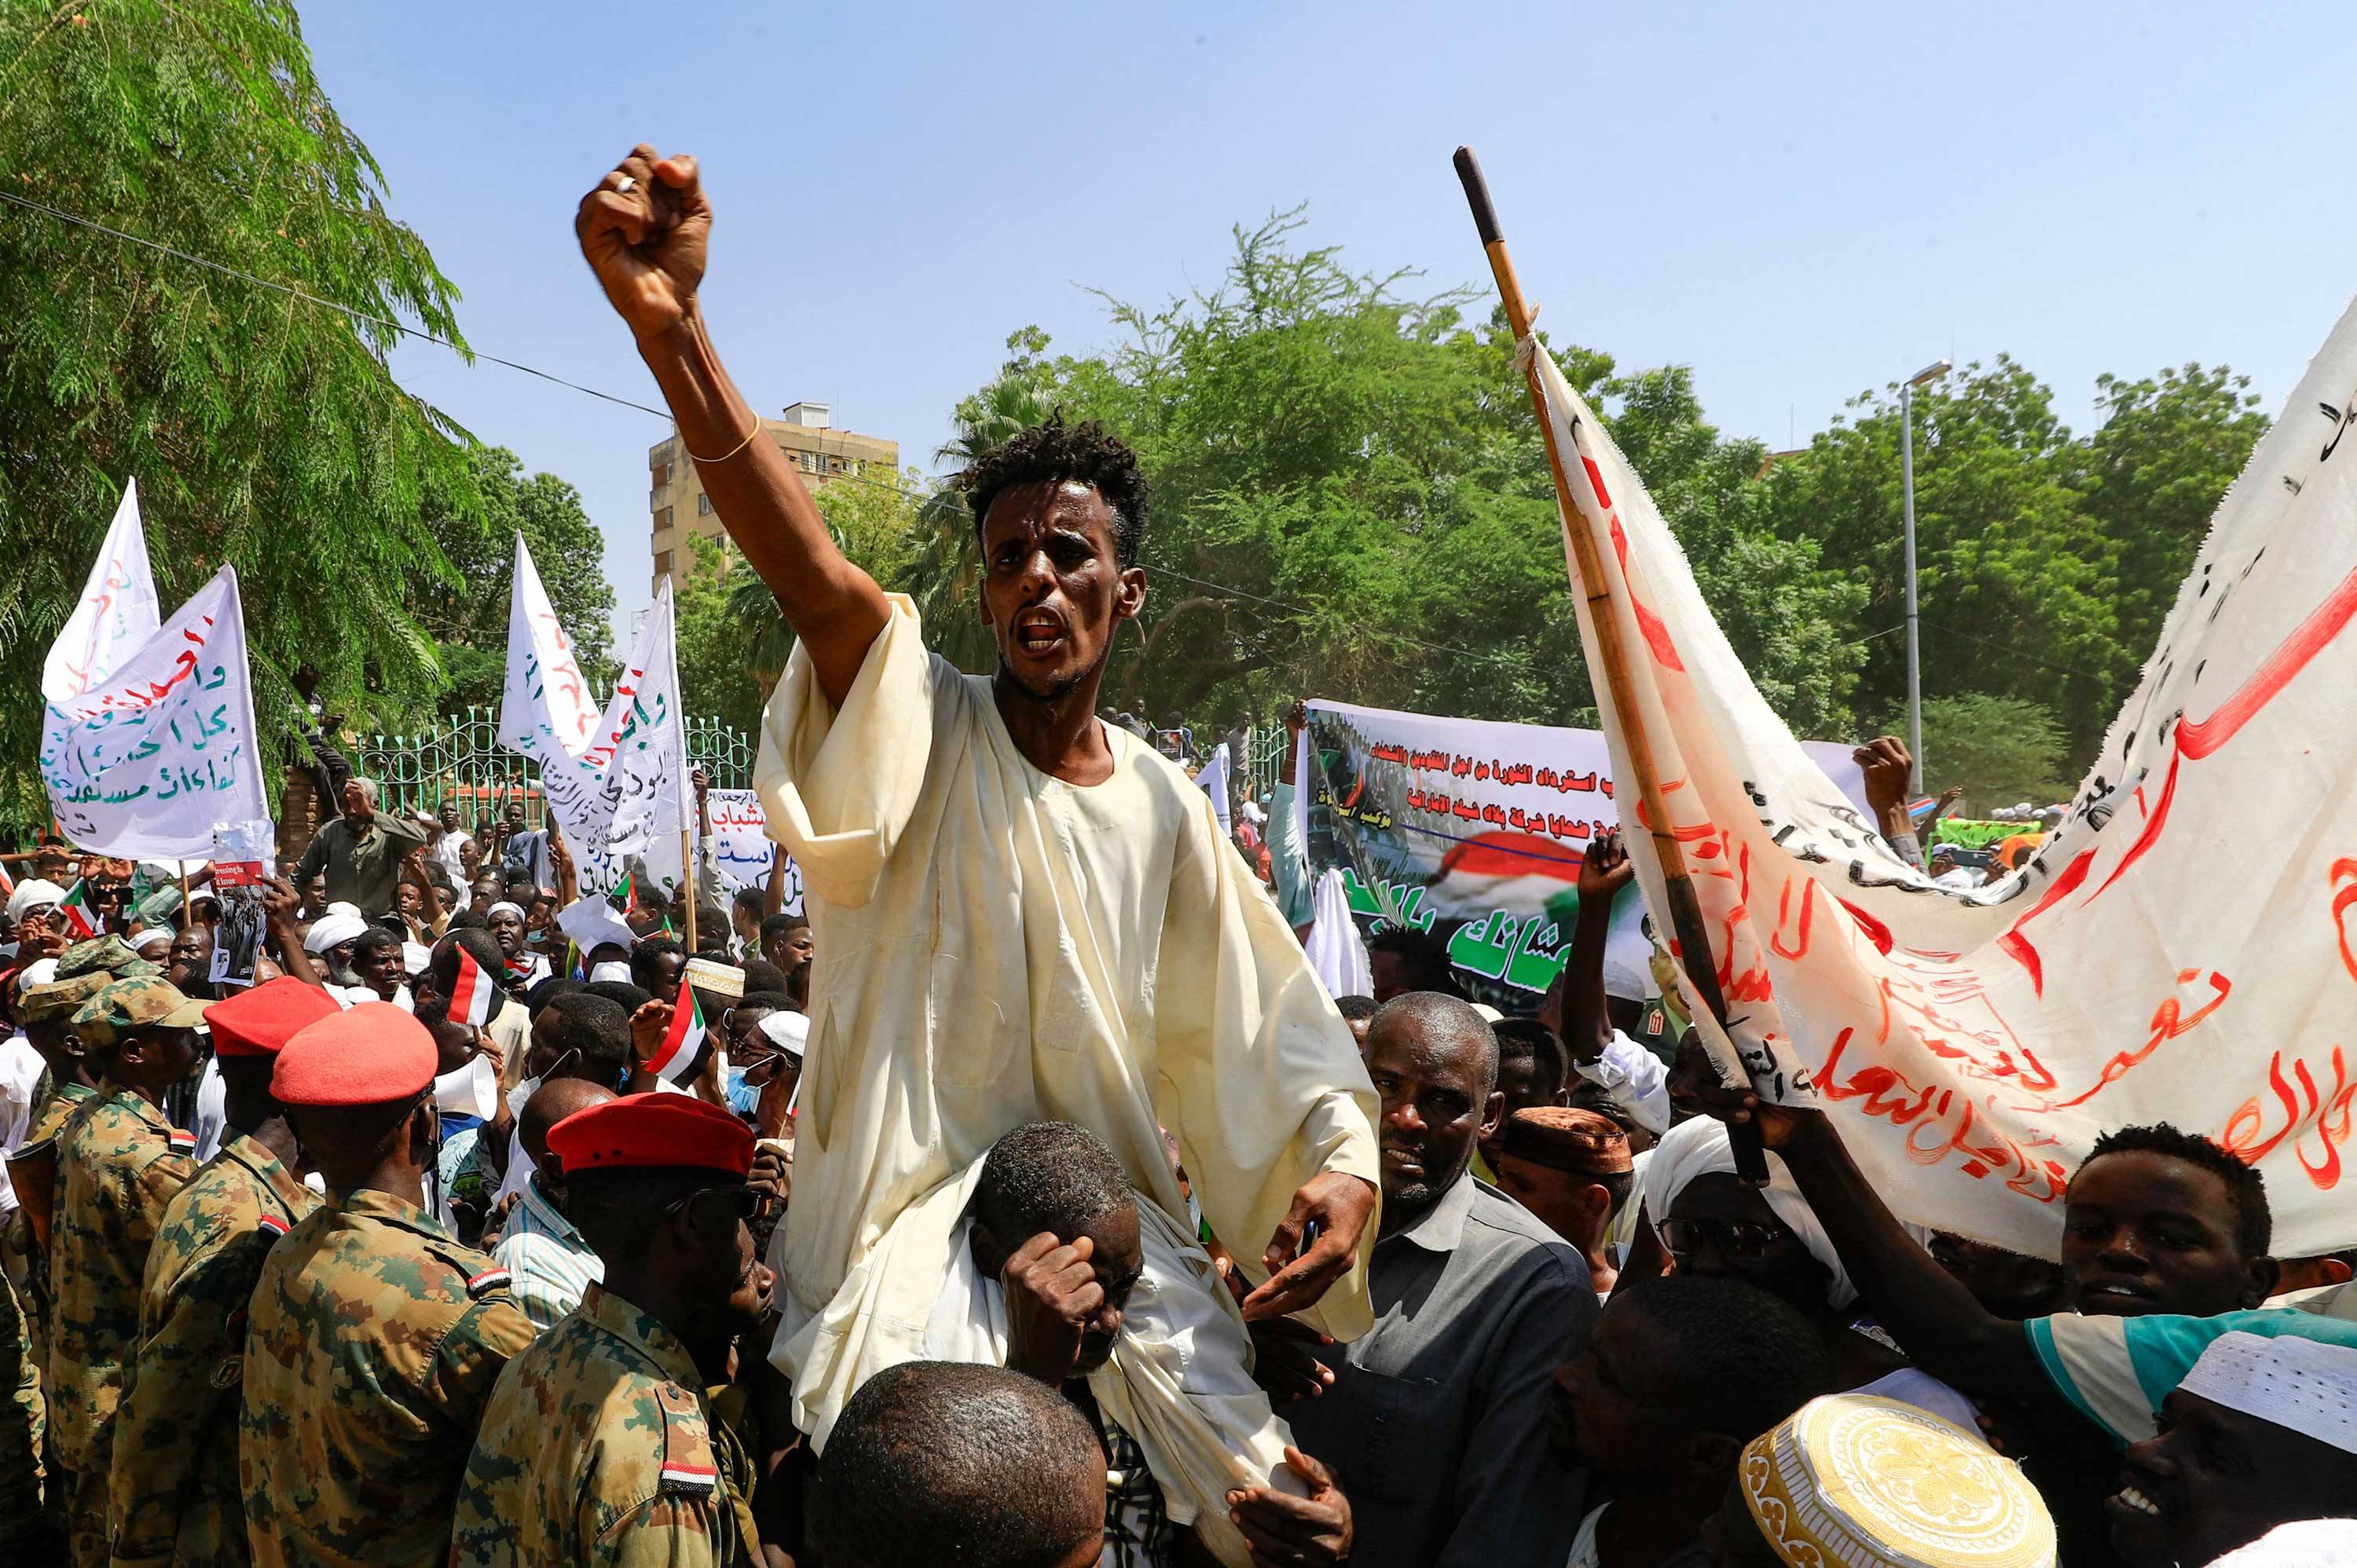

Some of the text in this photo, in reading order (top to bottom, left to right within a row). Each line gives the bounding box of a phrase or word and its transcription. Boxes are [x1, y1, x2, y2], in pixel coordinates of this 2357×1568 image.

[1474, 760, 1490, 781] من
[1492, 759, 1533, 785] الثورة
[1536, 767, 1596, 793] استرداد
[718, 791, 753, 805] الرحمن
[1508, 808, 1546, 834] شركة
[1549, 813, 1590, 839] ضحايا
[220, 877, 236, 886] Issue
